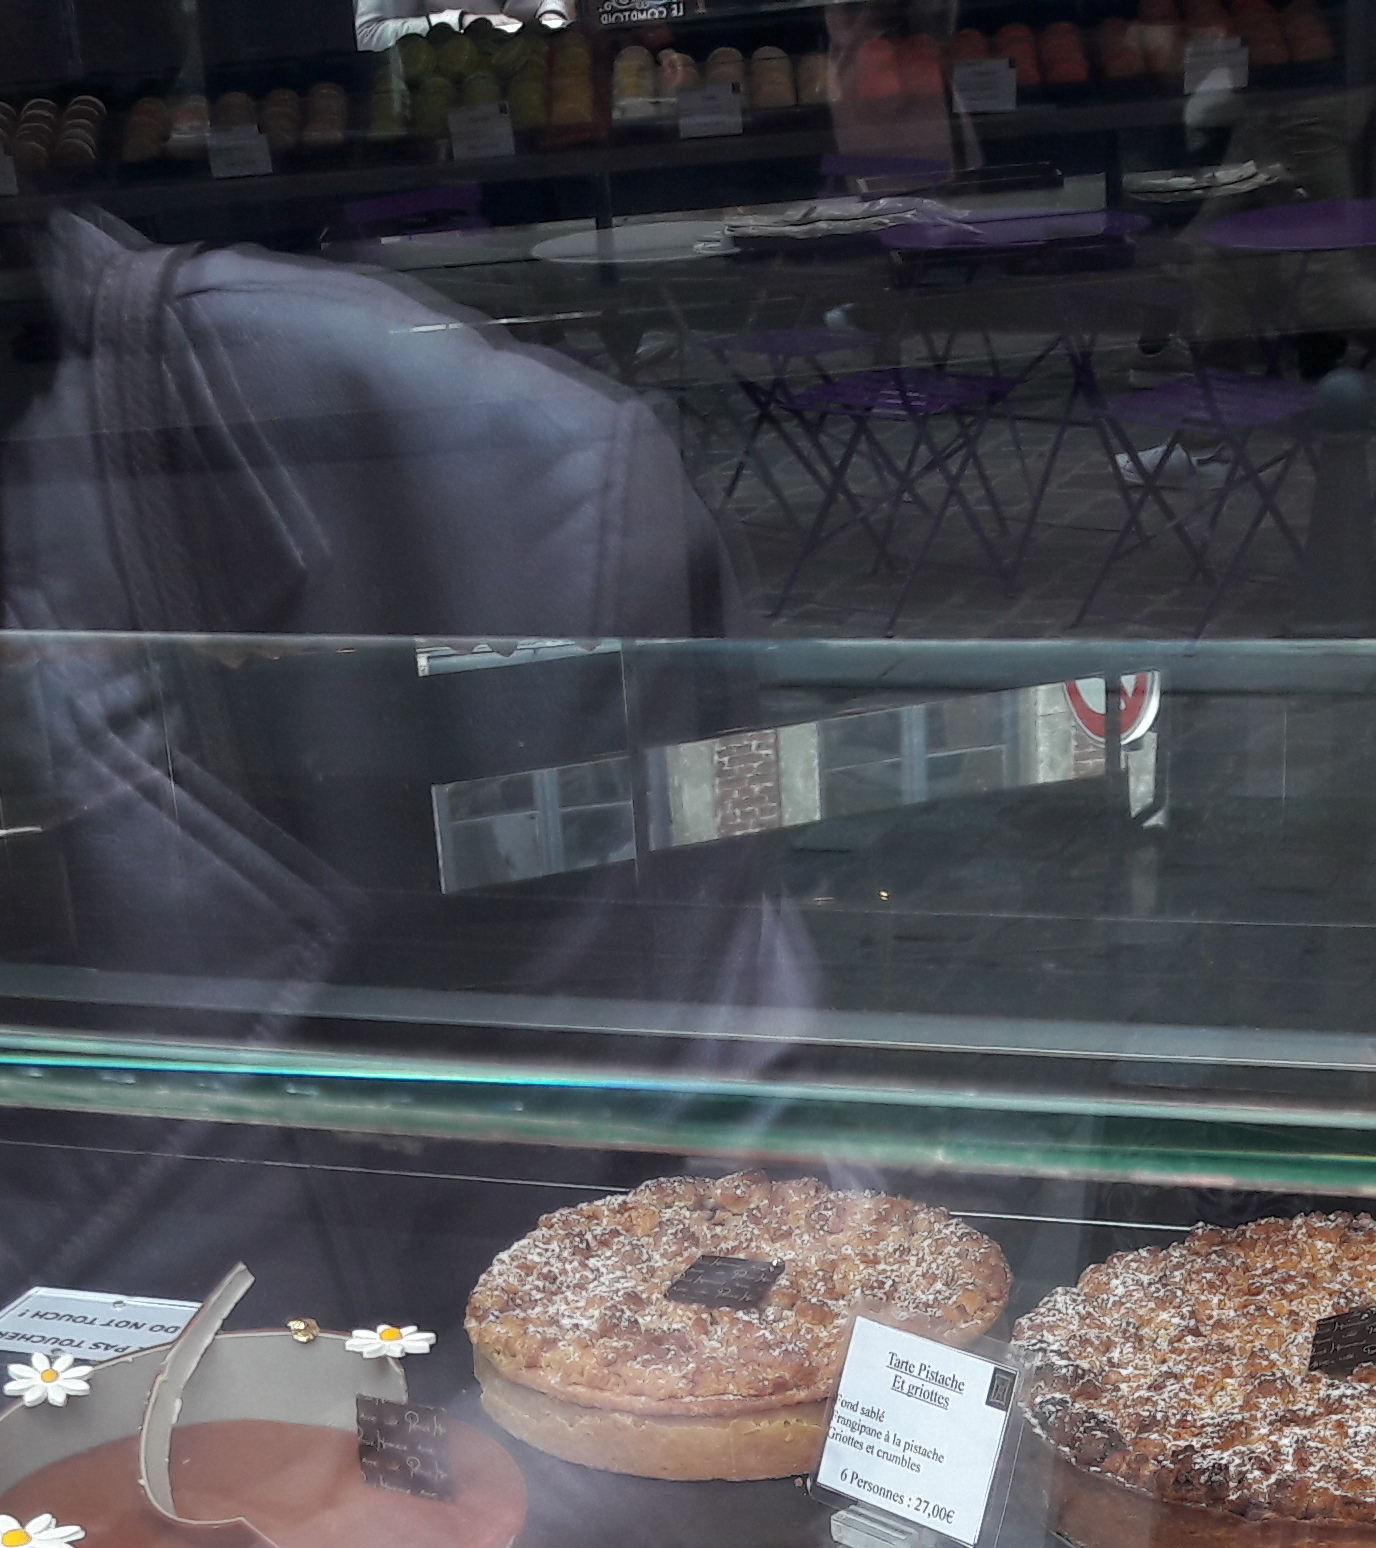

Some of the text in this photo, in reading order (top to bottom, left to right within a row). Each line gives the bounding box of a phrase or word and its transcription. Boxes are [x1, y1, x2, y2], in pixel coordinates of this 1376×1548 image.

[30, 1310, 97, 1325] TOUCH
[102, 1317, 147, 1331] NOT
[149, 1324, 182, 1335] DO
[889, 1352, 964, 1391] Tarte Pistache
[892, 1375, 949, 1410] Et griottes
[860, 1406, 885, 1422] sablé
[866, 1445, 874, 1455] et
[877, 1449, 920, 1472] crumbles
[884, 1431, 889, 1443] à
[893, 1433, 901, 1447] la
[903, 1440, 944, 1463] pistache
[841, 1469, 848, 1481] 6
[850, 1471, 904, 1504] Personnes
[914, 1498, 954, 1524] 27,00€
